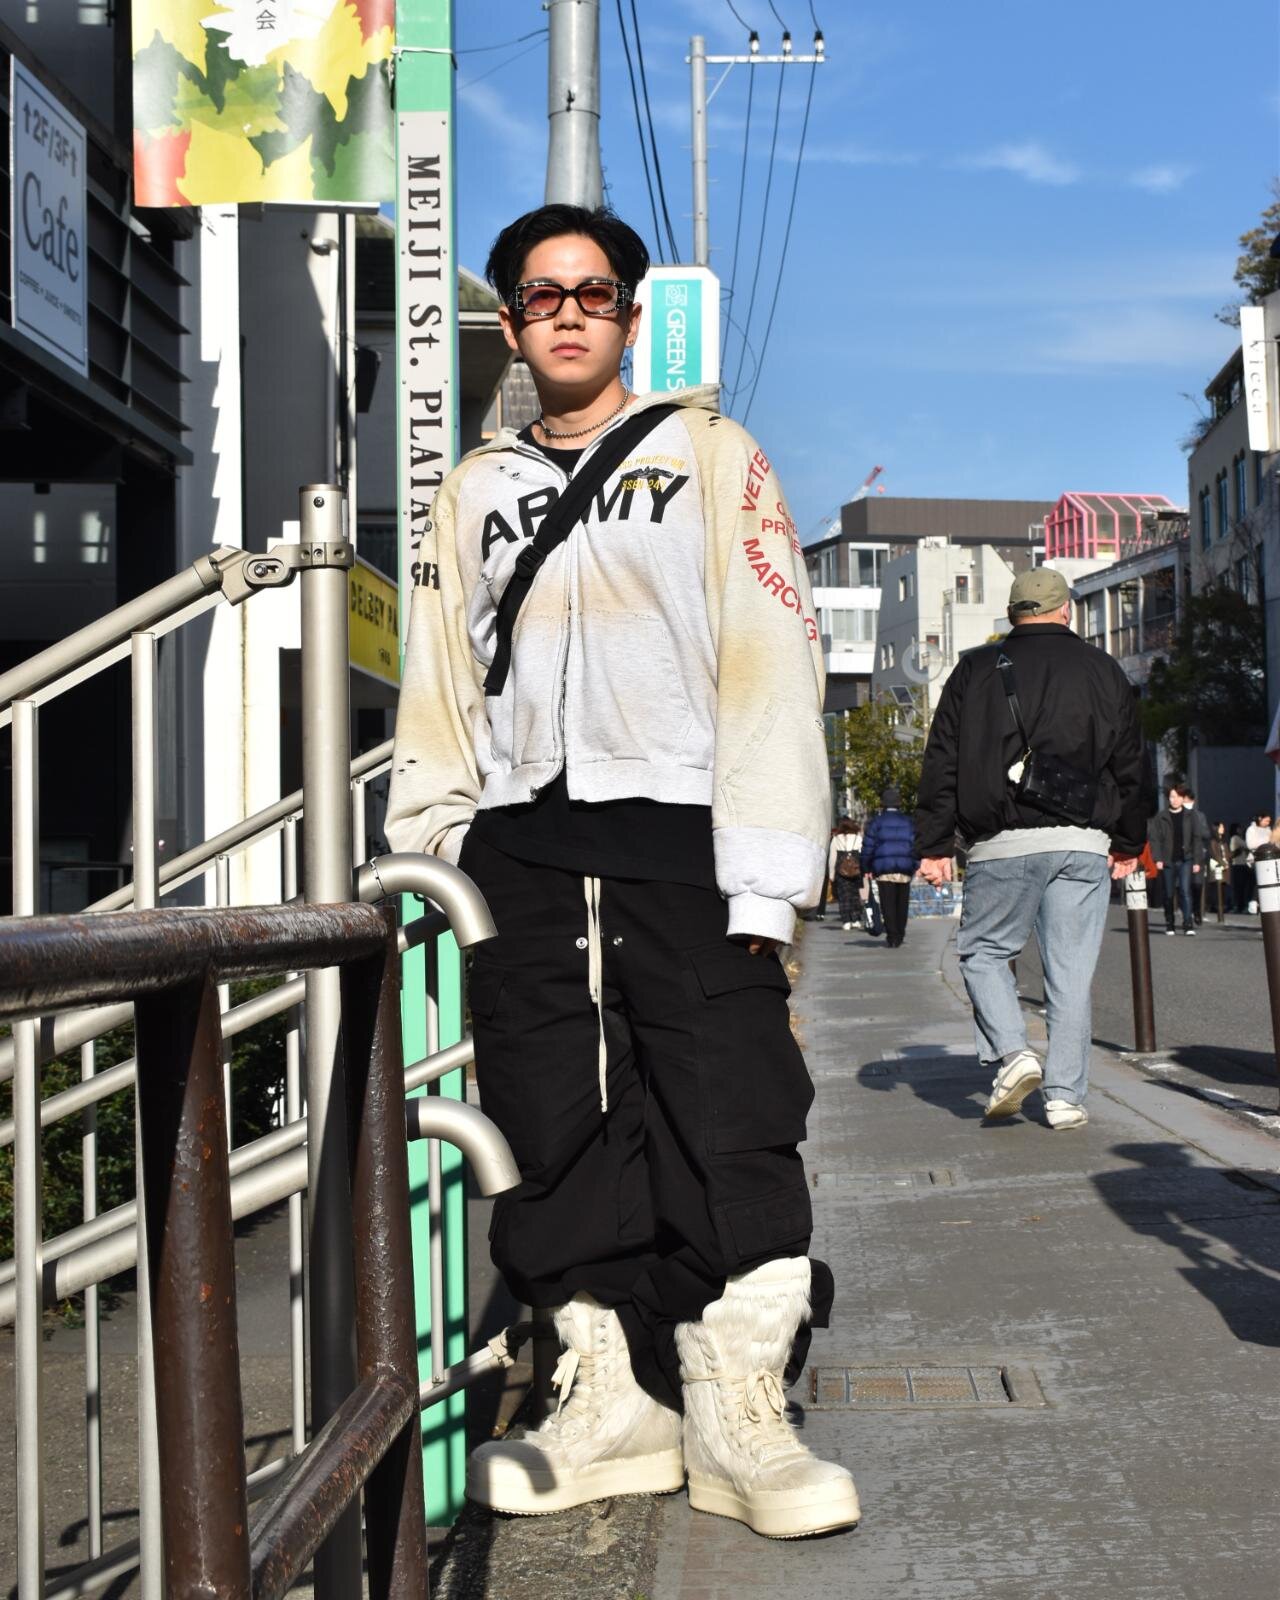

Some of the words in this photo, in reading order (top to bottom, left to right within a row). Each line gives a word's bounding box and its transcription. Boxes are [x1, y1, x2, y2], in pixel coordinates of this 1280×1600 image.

[256, 0, 277, 30] 会
[22, 171, 79, 284] Cafe
[407, 154, 441, 281] MEIJI
[408, 303, 442, 367] St.
[666, 308, 687, 375] GREEN
[481, 475, 690, 563] ARMY
